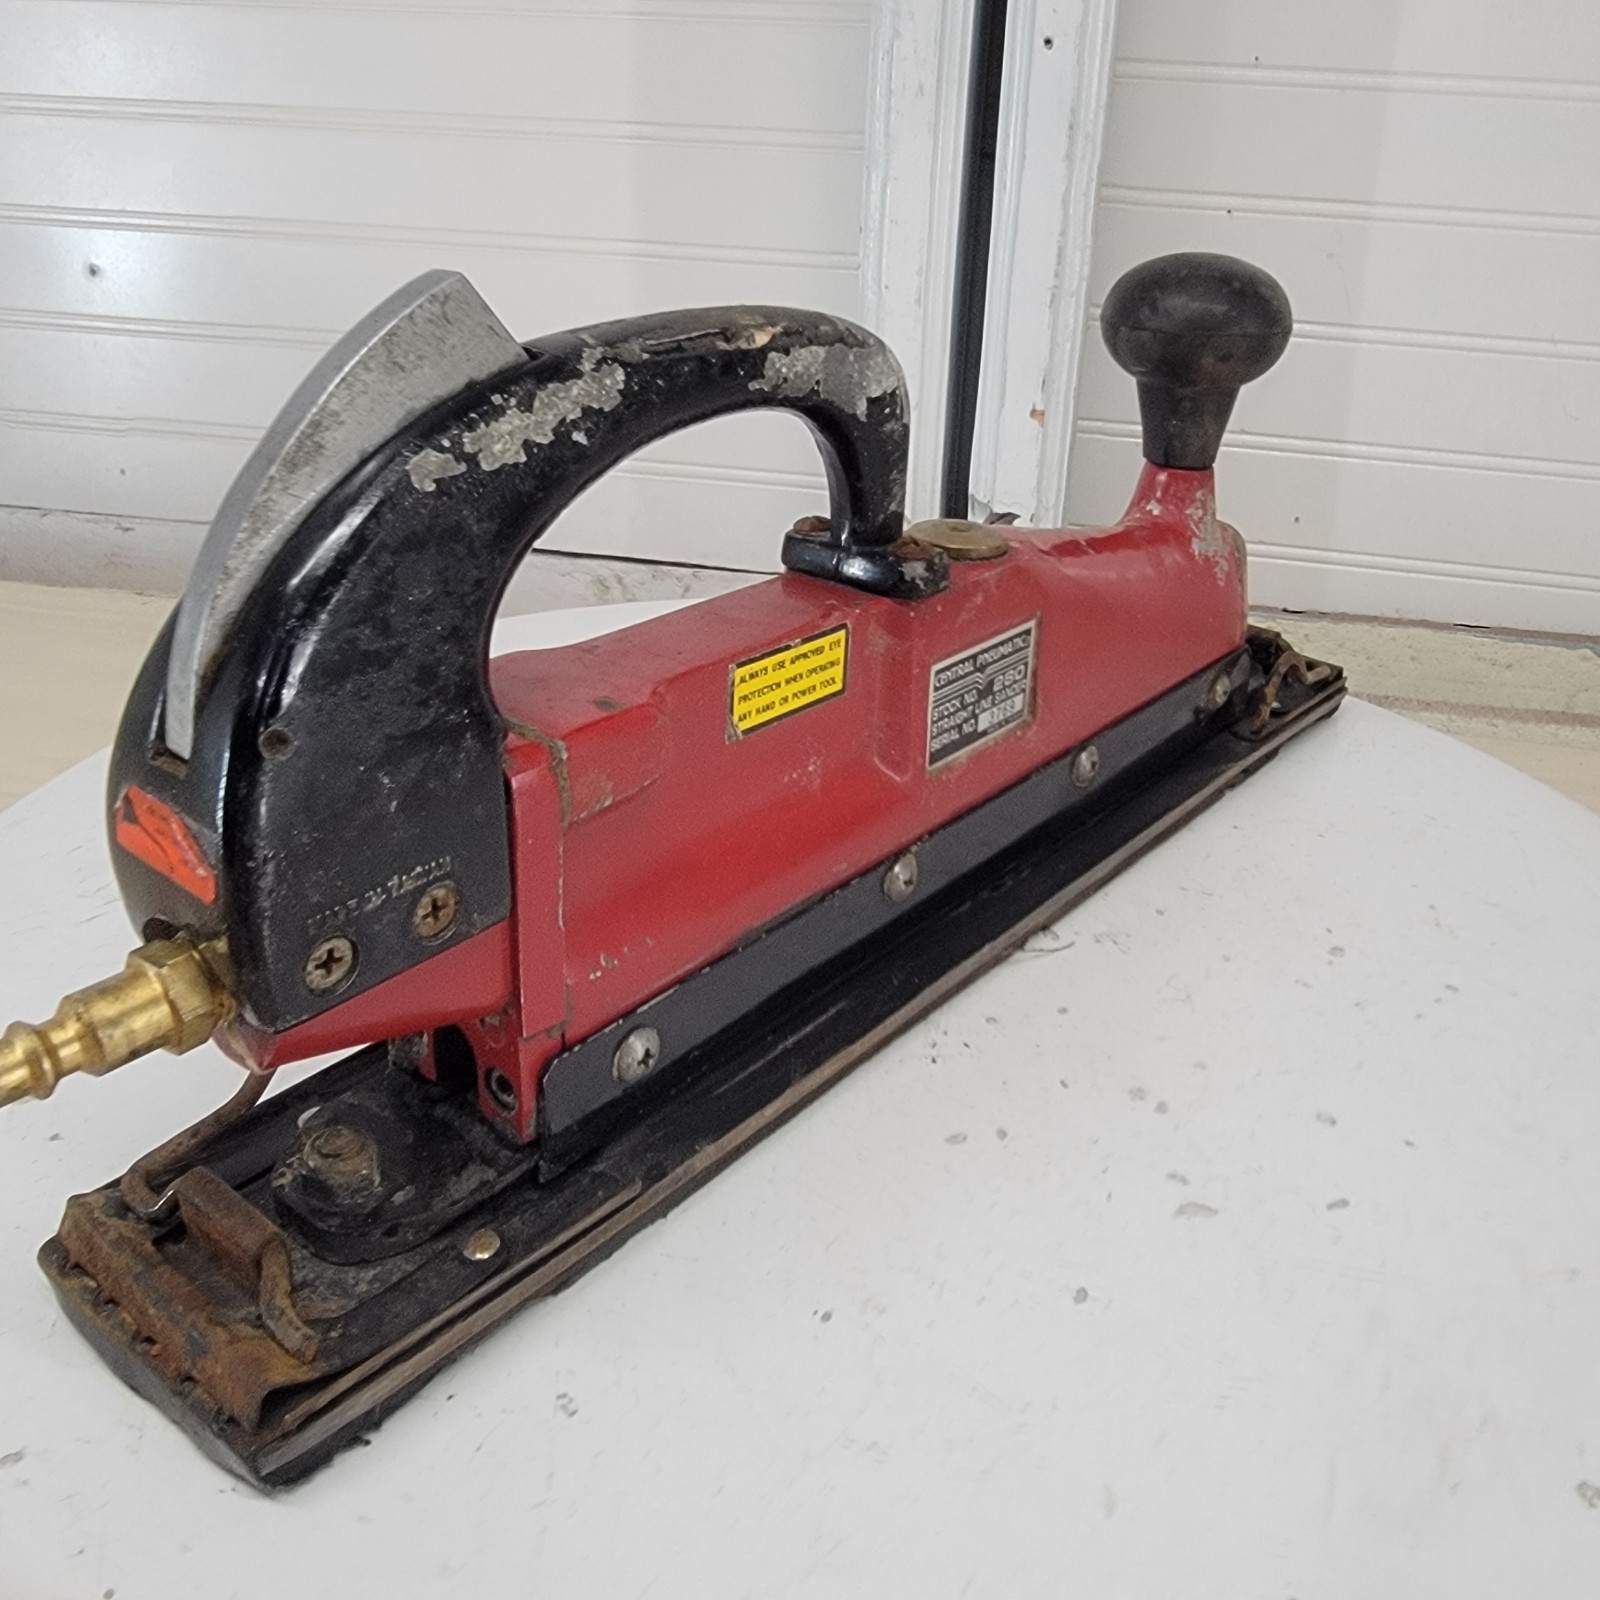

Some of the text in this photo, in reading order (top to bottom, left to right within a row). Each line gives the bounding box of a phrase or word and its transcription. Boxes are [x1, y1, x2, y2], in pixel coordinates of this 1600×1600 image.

[738, 657, 841, 705] PROTECTION WHEN OPERATING
[739, 638, 842, 684] ALWAYS USE APPROVED EYE
[935, 659, 974, 687] CENTRAL
[738, 676, 837, 722] ANY HAND OR POWER TOOL
[932, 705, 974, 736] STRAIGHT
[975, 695, 993, 715] LINE
[933, 697, 961, 721] STOCK
[931, 728, 960, 751] SERIAL
